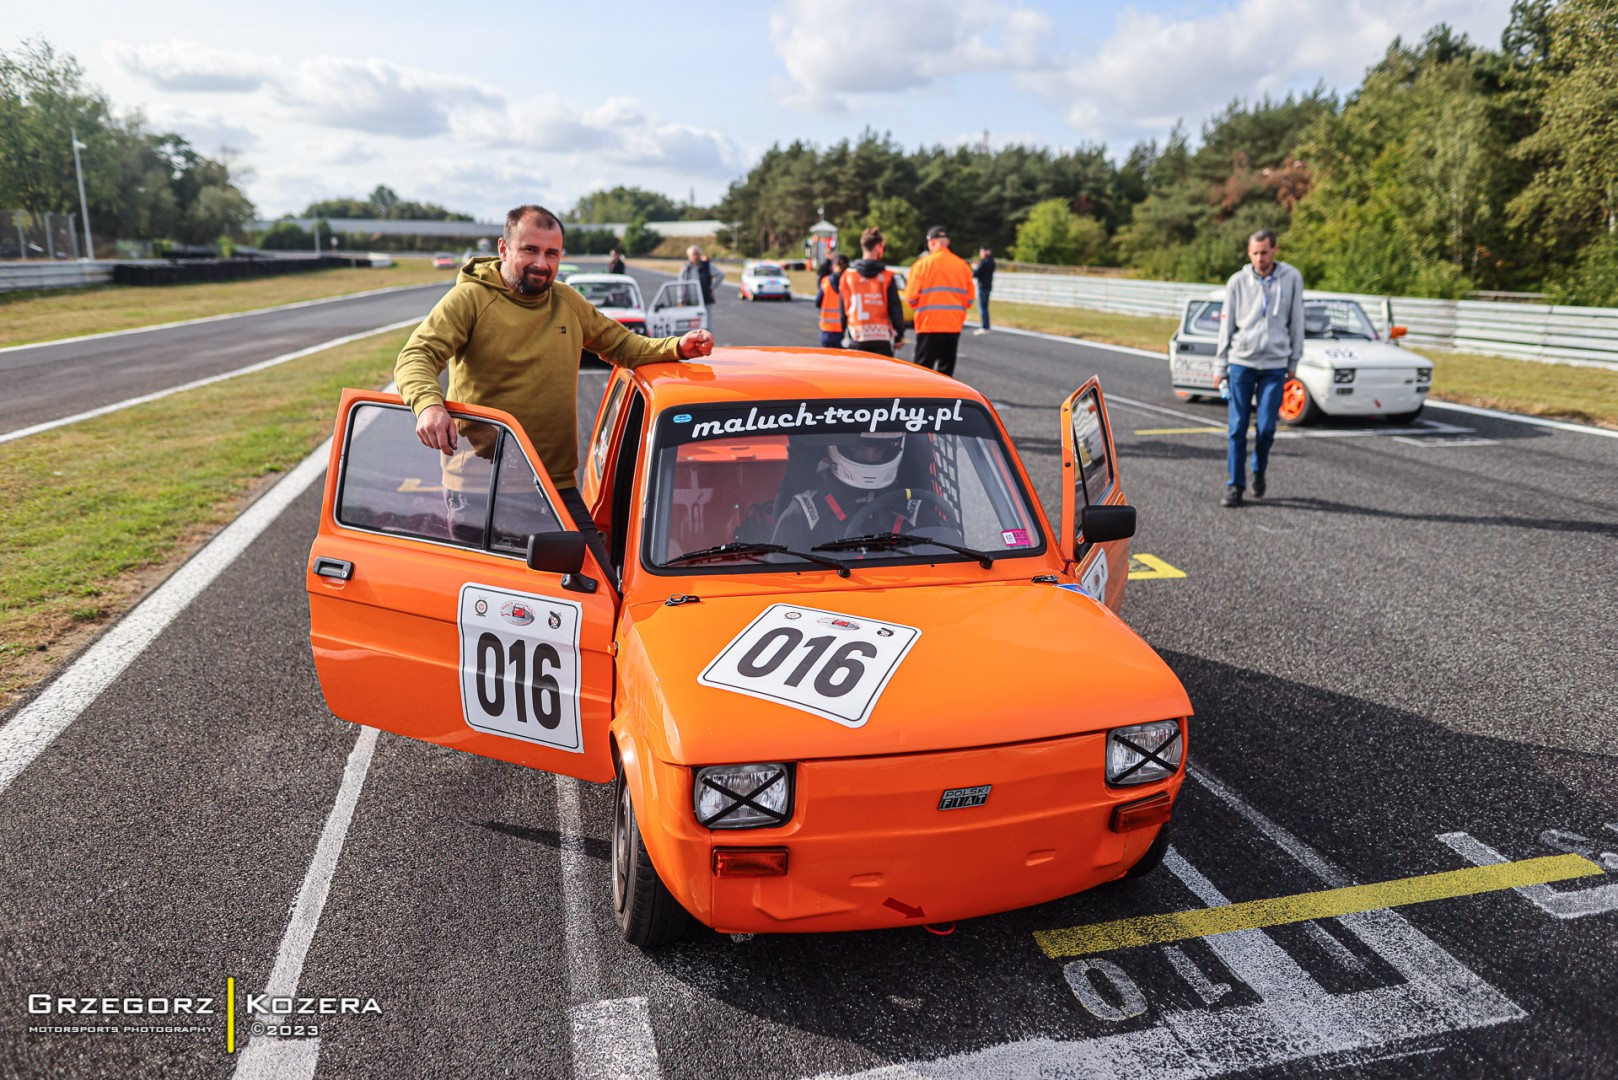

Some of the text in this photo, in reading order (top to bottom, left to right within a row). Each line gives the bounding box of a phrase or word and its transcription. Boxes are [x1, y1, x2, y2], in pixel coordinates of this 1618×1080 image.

[692, 398, 963, 439] maluch-trophy.pl
[476, 632, 562, 730] 016
[736, 627, 877, 699] 016
[942, 795, 986, 808] FIAT
[945, 786, 990, 798] POLSKI
